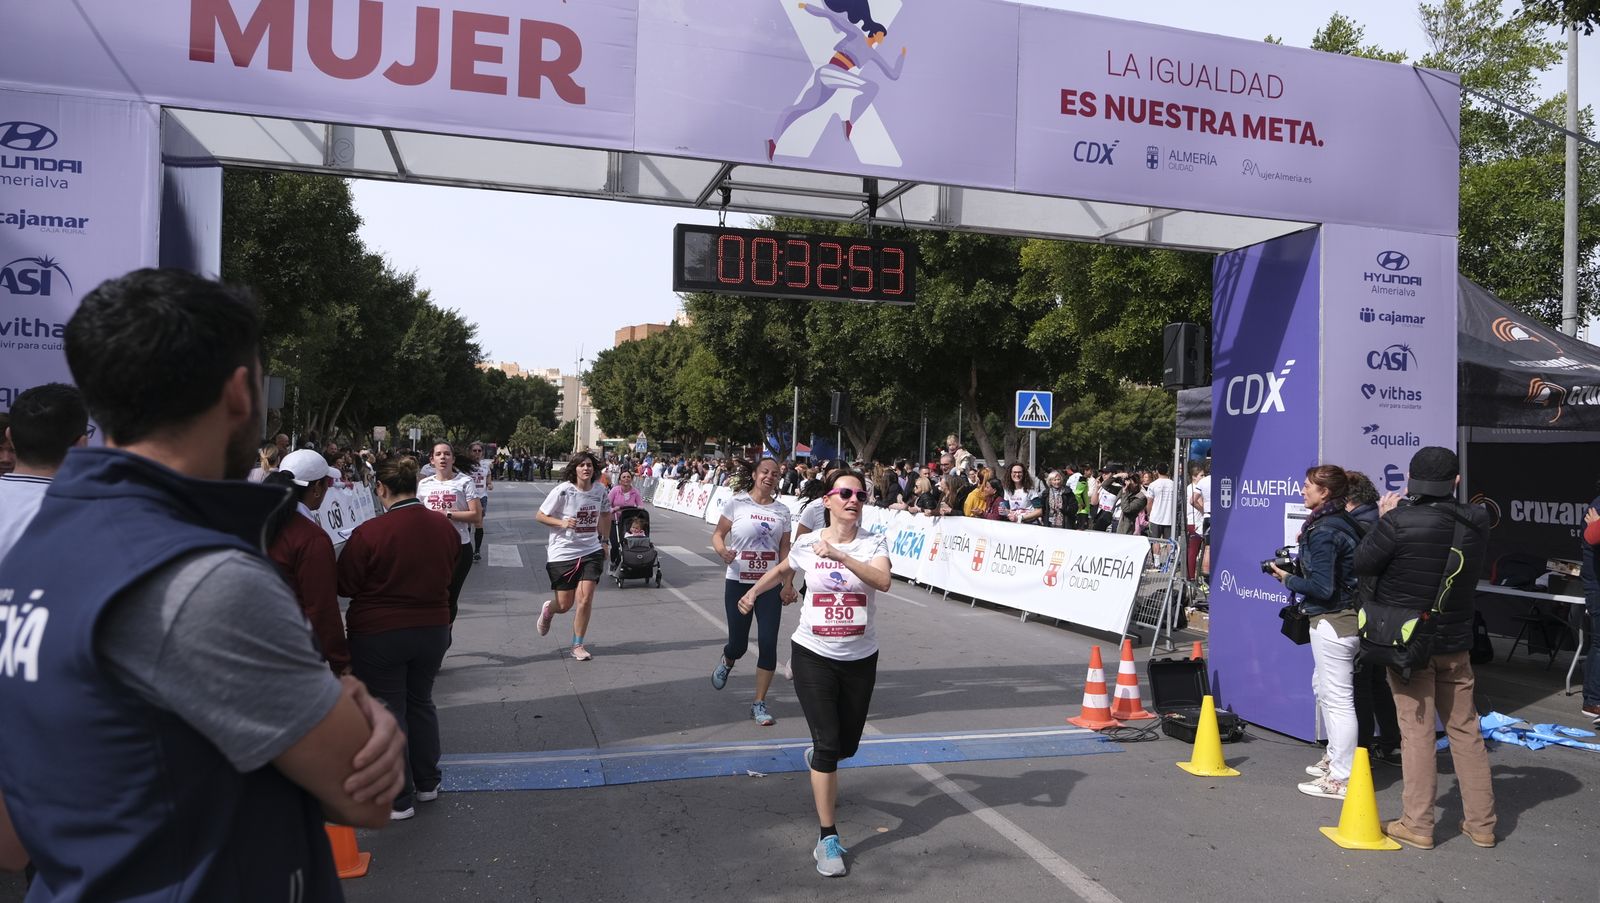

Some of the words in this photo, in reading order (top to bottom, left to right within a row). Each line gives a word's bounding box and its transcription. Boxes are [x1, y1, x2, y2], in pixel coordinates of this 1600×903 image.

[189, 0, 586, 105] MUJER
[1107, 50, 1140, 79] LA
[1150, 56, 1284, 99] IGUALDAD
[1060, 88, 1097, 117] ES
[1104, 94, 1236, 137] NUESTRA
[1242, 114, 1324, 147] META.
[1073, 139, 1120, 165] CDX
[1168, 149, 1218, 166] ALMERÍA
[1168, 163, 1194, 172] CIUDAD
[717, 234, 905, 295] 00:32:53
[1364, 272, 1422, 286] HYUNDAI
[1371, 284, 1416, 297] Almerialva
[1378, 311, 1426, 325] cajamar
[0, 317, 66, 338] vitha
[1366, 350, 1408, 371] CASI
[1226, 360, 1296, 416] CDX
[1380, 386, 1422, 401] vithas
[1370, 432, 1420, 449] aqualia
[1241, 478, 1302, 496] ALMERÍA
[431, 501, 453, 510] 2563
[1241, 497, 1270, 508] CIUDAD
[750, 514, 776, 523] MUJER
[748, 560, 768, 570] 839
[993, 546, 1044, 567] ALMERÍA
[815, 561, 846, 570] MUJE
[990, 565, 1016, 577] CIUDAD
[1070, 555, 1134, 580] ALMERÍA
[1068, 577, 1099, 592] CIUDAD
[1220, 569, 1302, 604] MujerAlmería.s
[824, 607, 855, 620] 850
